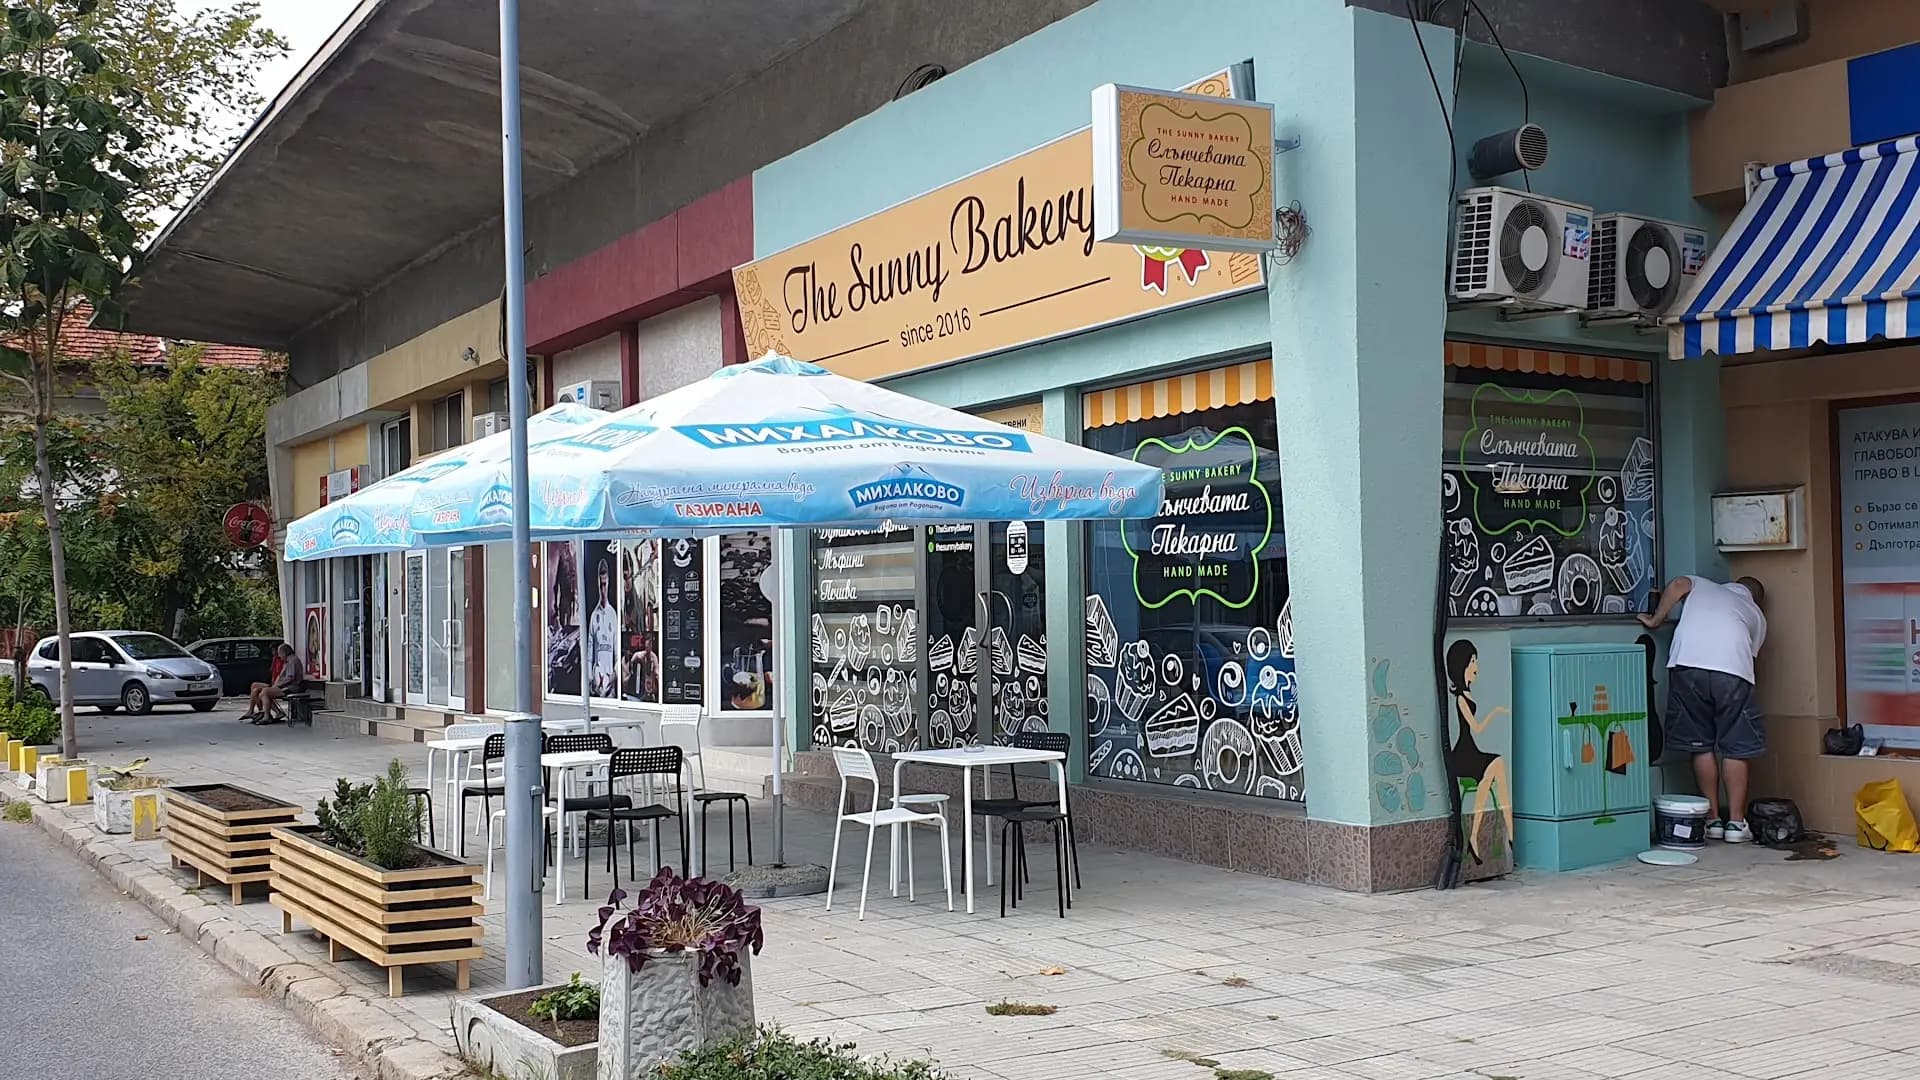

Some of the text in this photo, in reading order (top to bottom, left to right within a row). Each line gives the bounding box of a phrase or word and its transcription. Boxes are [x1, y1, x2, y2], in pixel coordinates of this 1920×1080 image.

[1157, 127, 1240, 143] THE SUNNY BAKERY
[1147, 138, 1247, 168] Слънчевата
[1159, 164, 1237, 194] Пекарна
[1171, 195, 1229, 207] HAND MADE
[783, 175, 1096, 334] The Sunny Bakery
[900, 307, 971, 347] since 2016
[1490, 415, 1571, 429] THE SUNNY BAKERY
[696, 419, 1014, 449] МИХАЛКОВО
[1480, 428, 1579, 458] Слънчевата
[1854, 428, 1909, 443] АТАКУВА
[776, 443, 854, 455] Водата
[859, 441, 888, 449] от
[1170, 469, 1201, 481] SUNNY
[1204, 463, 1242, 479] BAKERY
[1491, 461, 1570, 496] Пекарна
[1854, 467, 1898, 481] ПРАВО
[1901, 466, 1910, 478] В
[787, 472, 815, 502] вода
[855, 482, 960, 504] МИХАЛКОВО
[1009, 469, 1137, 516] Изворна вода
[674, 501, 762, 517] ГАЗИРАНА
[1157, 484, 1250, 517] лънчевата
[1503, 498, 1561, 510] HAND MADE
[1867, 502, 1901, 513] Бързо
[1151, 523, 1239, 561] Пекарна
[818, 548, 865, 574] Мъфини
[1163, 564, 1228, 578] HAND MADE
[820, 578, 858, 601] Печива
